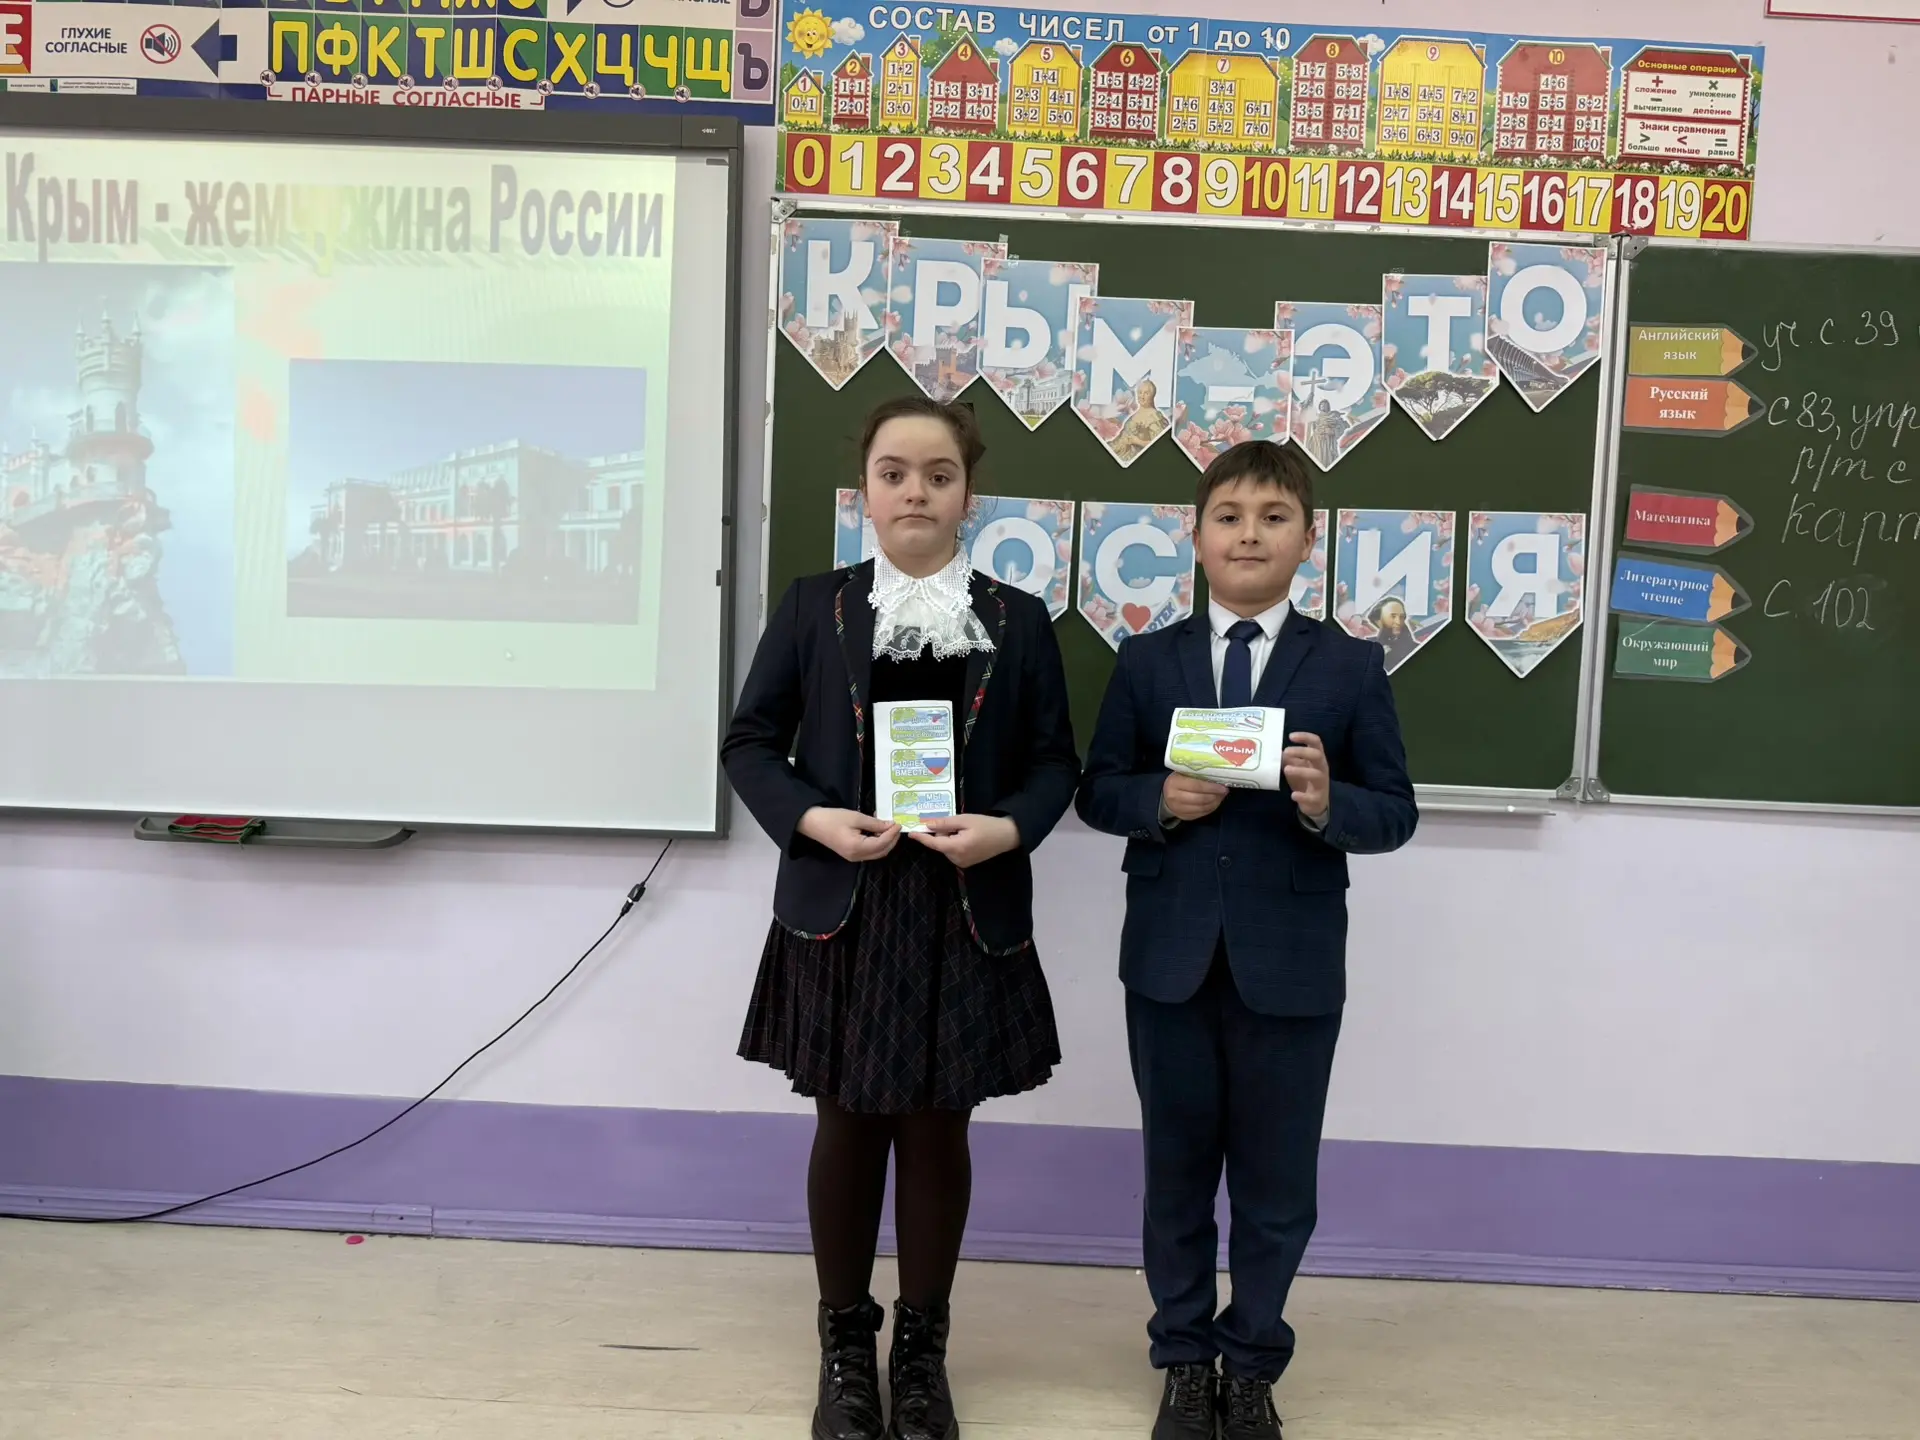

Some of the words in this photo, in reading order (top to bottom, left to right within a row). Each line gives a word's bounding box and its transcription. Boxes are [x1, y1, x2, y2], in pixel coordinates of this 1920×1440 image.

[61, 27, 111, 40] ГЛУХИЕ
[869, 5, 996, 33] СОСТАВ
[1019, 12, 1124, 42] ЧИСЕЛ
[1148, 26, 1179, 44] от
[1188, 22, 1200, 45] 1
[1214, 29, 1251, 51] до
[1262, 27, 1292, 50] 10
[45, 41, 128, 54] СОГЛАСНЫЕ
[897, 44, 906, 57] 3
[959, 45, 969, 59] 4
[1042, 48, 1050, 60] 5
[1328, 44, 1336, 56] 8
[1429, 47, 1437, 60] 9
[273, 21, 308, 73] П
[316, 22, 358, 75] Ф
[368, 25, 401, 78] К
[415, 27, 446, 79] Т
[453, 28, 493, 79] Ш
[502, 28, 540, 81] С
[551, 32, 587, 86] Х
[596, 33, 634, 87] Ц
[644, 34, 678, 88] Ч
[685, 37, 731, 93] Щ
[1123, 51, 1131, 64] 6
[1552, 51, 1562, 62] 10
[738, 42, 770, 91] Ъ
[849, 61, 857, 73] 2
[1220, 60, 1227, 72] 7
[1638, 60, 1687, 71] Основные
[1690, 65, 1737, 75] операции
[800, 77, 809, 91] 1
[292, 87, 380, 105] ПАРНЫЕ
[393, 90, 521, 108] СОГЛАСНЫЕ
[1635, 87, 1677, 95] сложение
[1689, 90, 1736, 99] умножение
[1633, 104, 1683, 113] вычитание
[1693, 108, 1732, 116] деление
[1639, 122, 1670, 132] Знаки
[1672, 126, 1726, 135] сравнения
[1627, 143, 1660, 152] больше
[1664, 147, 1700, 155] меньше
[1707, 149, 1735, 157] равно
[793, 138, 825, 187] 0
[839, 141, 863, 191] 1
[882, 143, 914, 191] 2
[928, 143, 961, 194] 3
[969, 147, 1005, 195] 4
[1019, 148, 1053, 199] 5
[1066, 152, 1098, 200] 6
[1114, 154, 1148, 204] 7
[1160, 157, 1193, 205] 8
[1205, 158, 1238, 207] 9
[1245, 162, 1286, 211] 10
[1292, 163, 1331, 213] 11
[1337, 165, 1380, 216] 12
[1386, 166, 1428, 218] 13
[1432, 169, 1475, 220] 14
[1477, 171, 1520, 222] 15
[1522, 174, 1564, 224] 16
[1567, 174, 1611, 227] 17
[1614, 178, 1655, 229] 18
[1659, 180, 1699, 231] 19
[1703, 183, 1747, 234] 20
[5, 152, 139, 262] Крым
[490, 163, 663, 258] России
[1855, 310, 1900, 346] 39
[1638, 329, 1720, 343] Английский
[1663, 351, 1697, 361] язык
[1650, 387, 1708, 402] Русский
[1659, 408, 1697, 420] язык
[1634, 510, 1711, 527] Математика
[1620, 570, 1710, 592] Литературное
[1640, 592, 1684, 606] чтение
[1812, 580, 1875, 630] 102
[1622, 636, 1710, 653] Окружающий
[1652, 656, 1678, 670] мир
[1219, 745, 1255, 755] КРЫМ
[895, 768, 928, 776] ВМЕСТЕ
